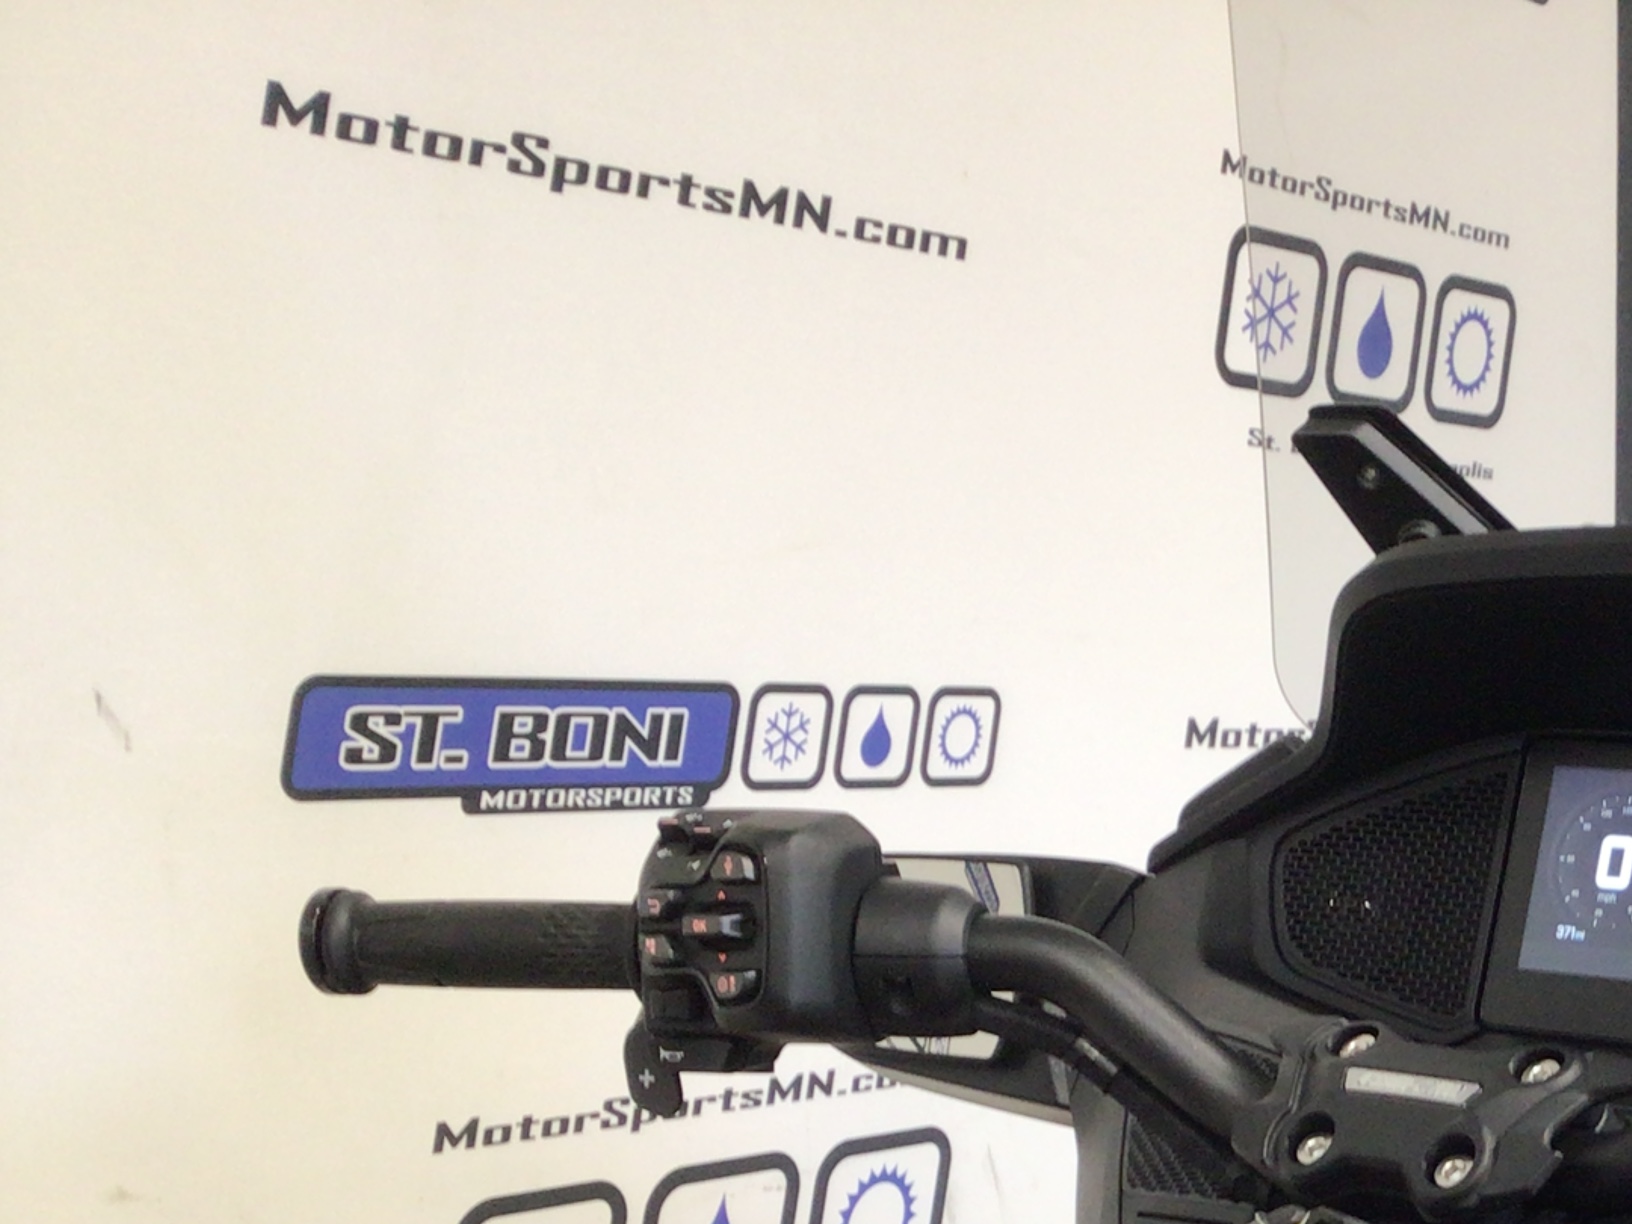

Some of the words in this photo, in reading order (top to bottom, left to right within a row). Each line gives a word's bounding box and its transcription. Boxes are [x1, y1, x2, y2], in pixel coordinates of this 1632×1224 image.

[261, 79, 967, 262] MotorSportsMN.com
[1220, 148, 1510, 250] MotorSportsMN.com
[339, 704, 469, 771] ST.
[487, 705, 689, 770] BONI
[479, 785, 693, 812] MOTORSPORTS
